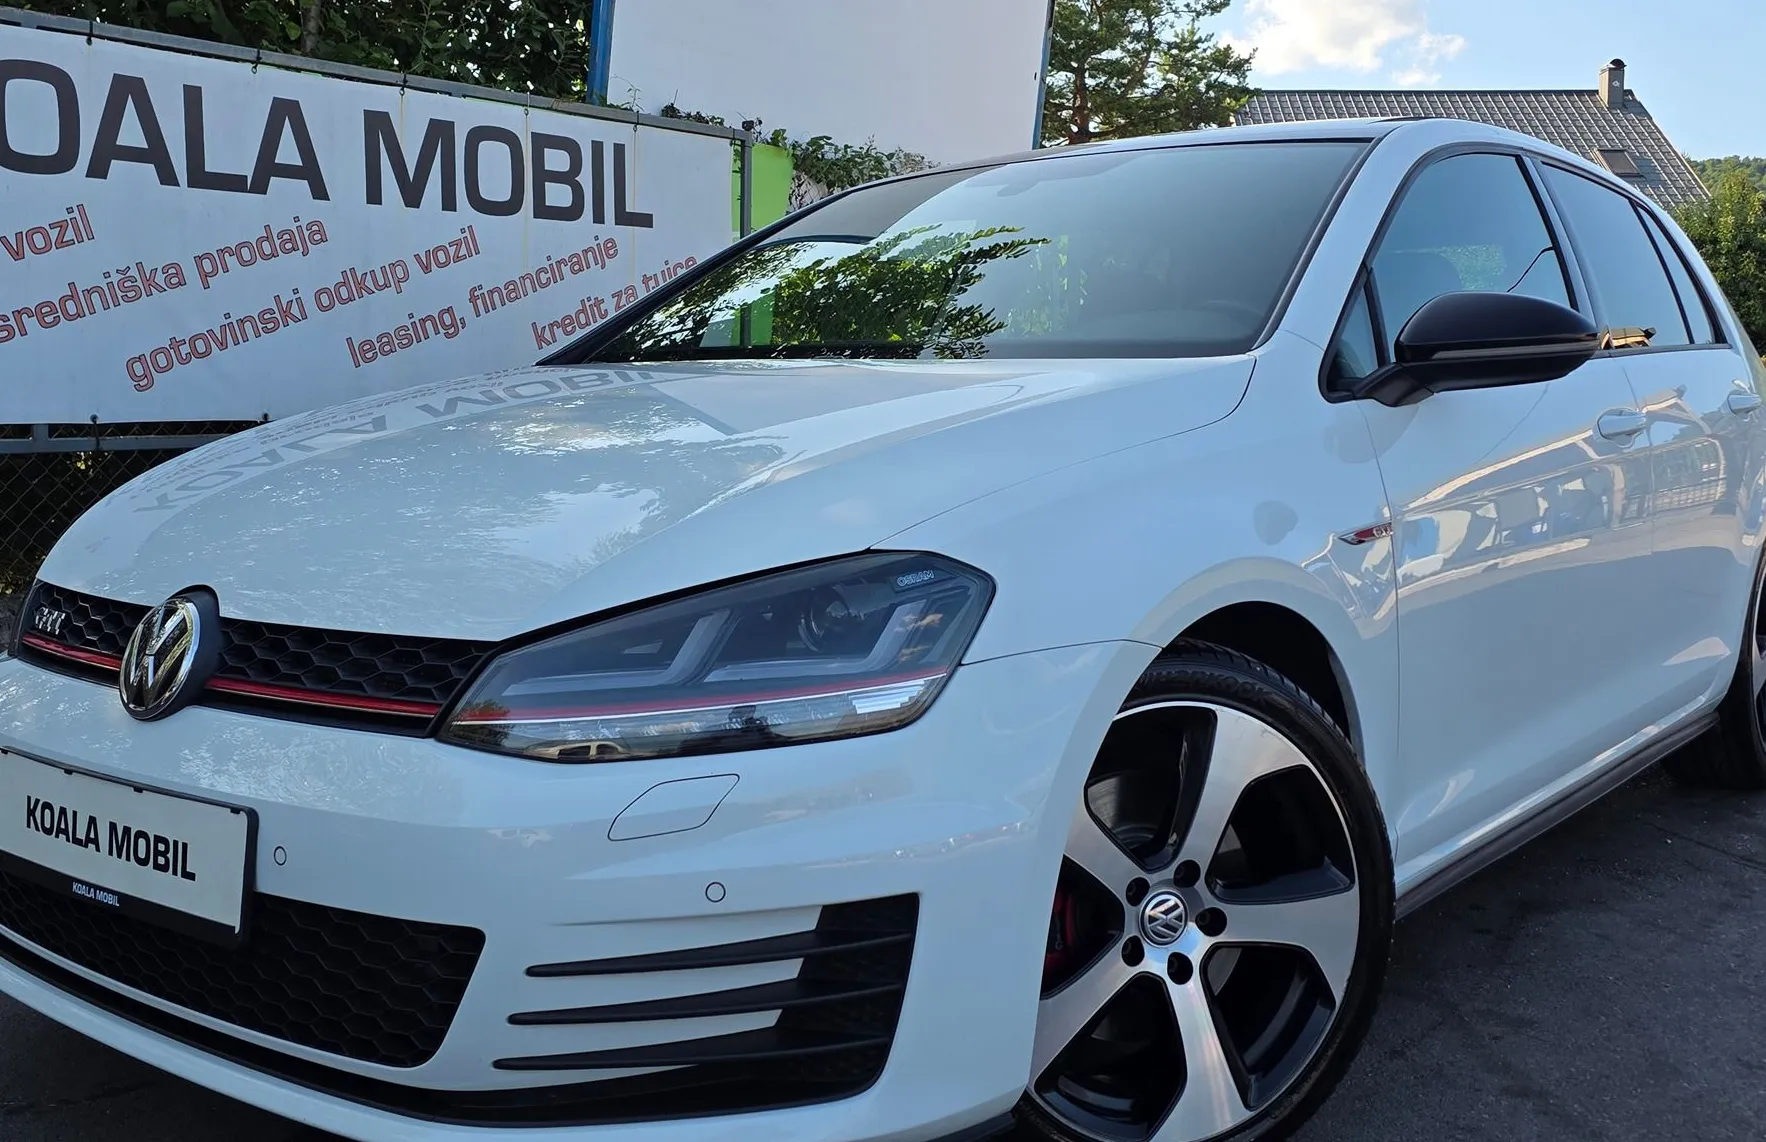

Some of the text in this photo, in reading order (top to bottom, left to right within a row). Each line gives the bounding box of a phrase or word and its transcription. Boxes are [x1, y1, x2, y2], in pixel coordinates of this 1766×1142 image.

[363, 108, 654, 229] MOBIL
[0, 203, 95, 262] vozil
[193, 216, 329, 290] prodaja
[125, 225, 481, 393] gotovinski odkup vozil
[346, 234, 619, 369] leasing, financiranje
[531, 295, 608, 350] kredit
[611, 284, 638, 312] za
[896, 569, 935, 587] OSRAM
[26, 795, 197, 882] KOALA MOBIL
[72, 881, 120, 907] KOALA MOBIL
